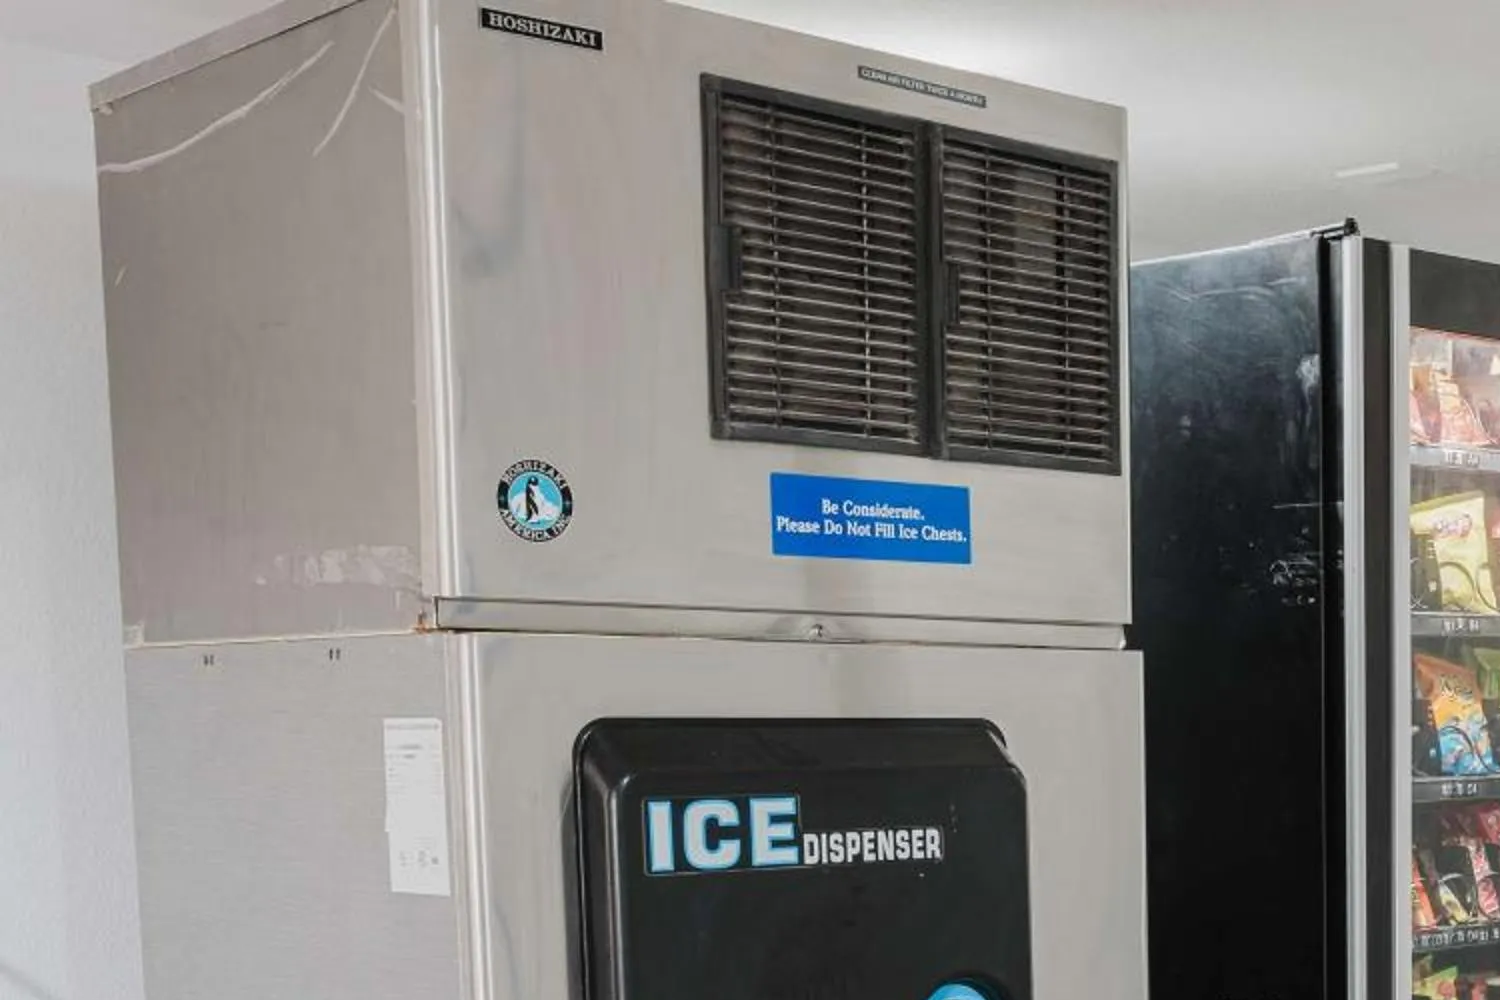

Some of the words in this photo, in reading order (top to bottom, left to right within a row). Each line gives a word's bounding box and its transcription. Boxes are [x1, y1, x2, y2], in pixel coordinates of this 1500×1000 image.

[488, 12, 597, 47] HOSHIZAKI
[821, 498, 839, 515] Be
[843, 500, 925, 521] Considerate.
[776, 515, 820, 534] Please
[824, 519, 843, 535] Do
[847, 521, 871, 537] Not
[874, 522, 895, 539] Fill
[899, 524, 918, 540] Ice
[921, 525, 967, 542] Chests.
[645, 794, 800, 873] ICE
[803, 827, 942, 866] DISPENSER
